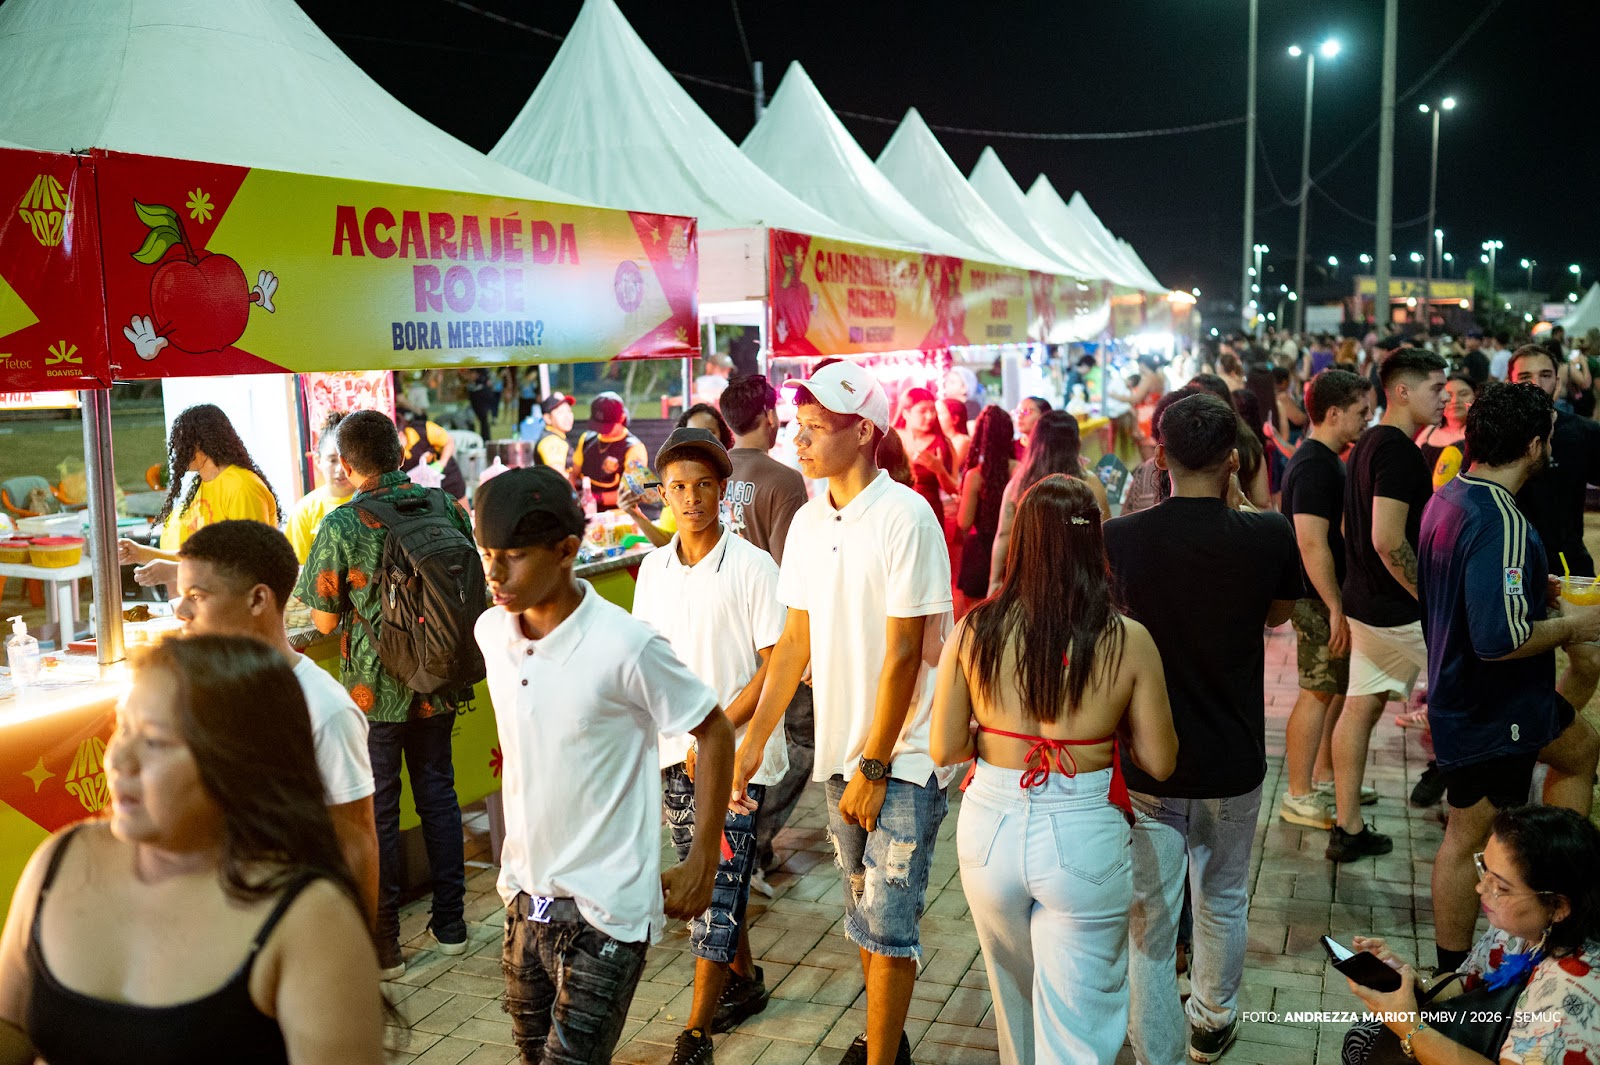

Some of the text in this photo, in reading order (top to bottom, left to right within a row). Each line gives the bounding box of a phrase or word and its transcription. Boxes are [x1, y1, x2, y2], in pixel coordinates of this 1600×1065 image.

[332, 204, 580, 265] ACARAJÉ DA
[412, 264, 525, 313] ROSE
[391, 319, 544, 351] BORA MERENDAR?
[5, 358, 33, 369] fetec
[725, 480, 755, 506] AGO
[65, 772, 111, 813] 202
